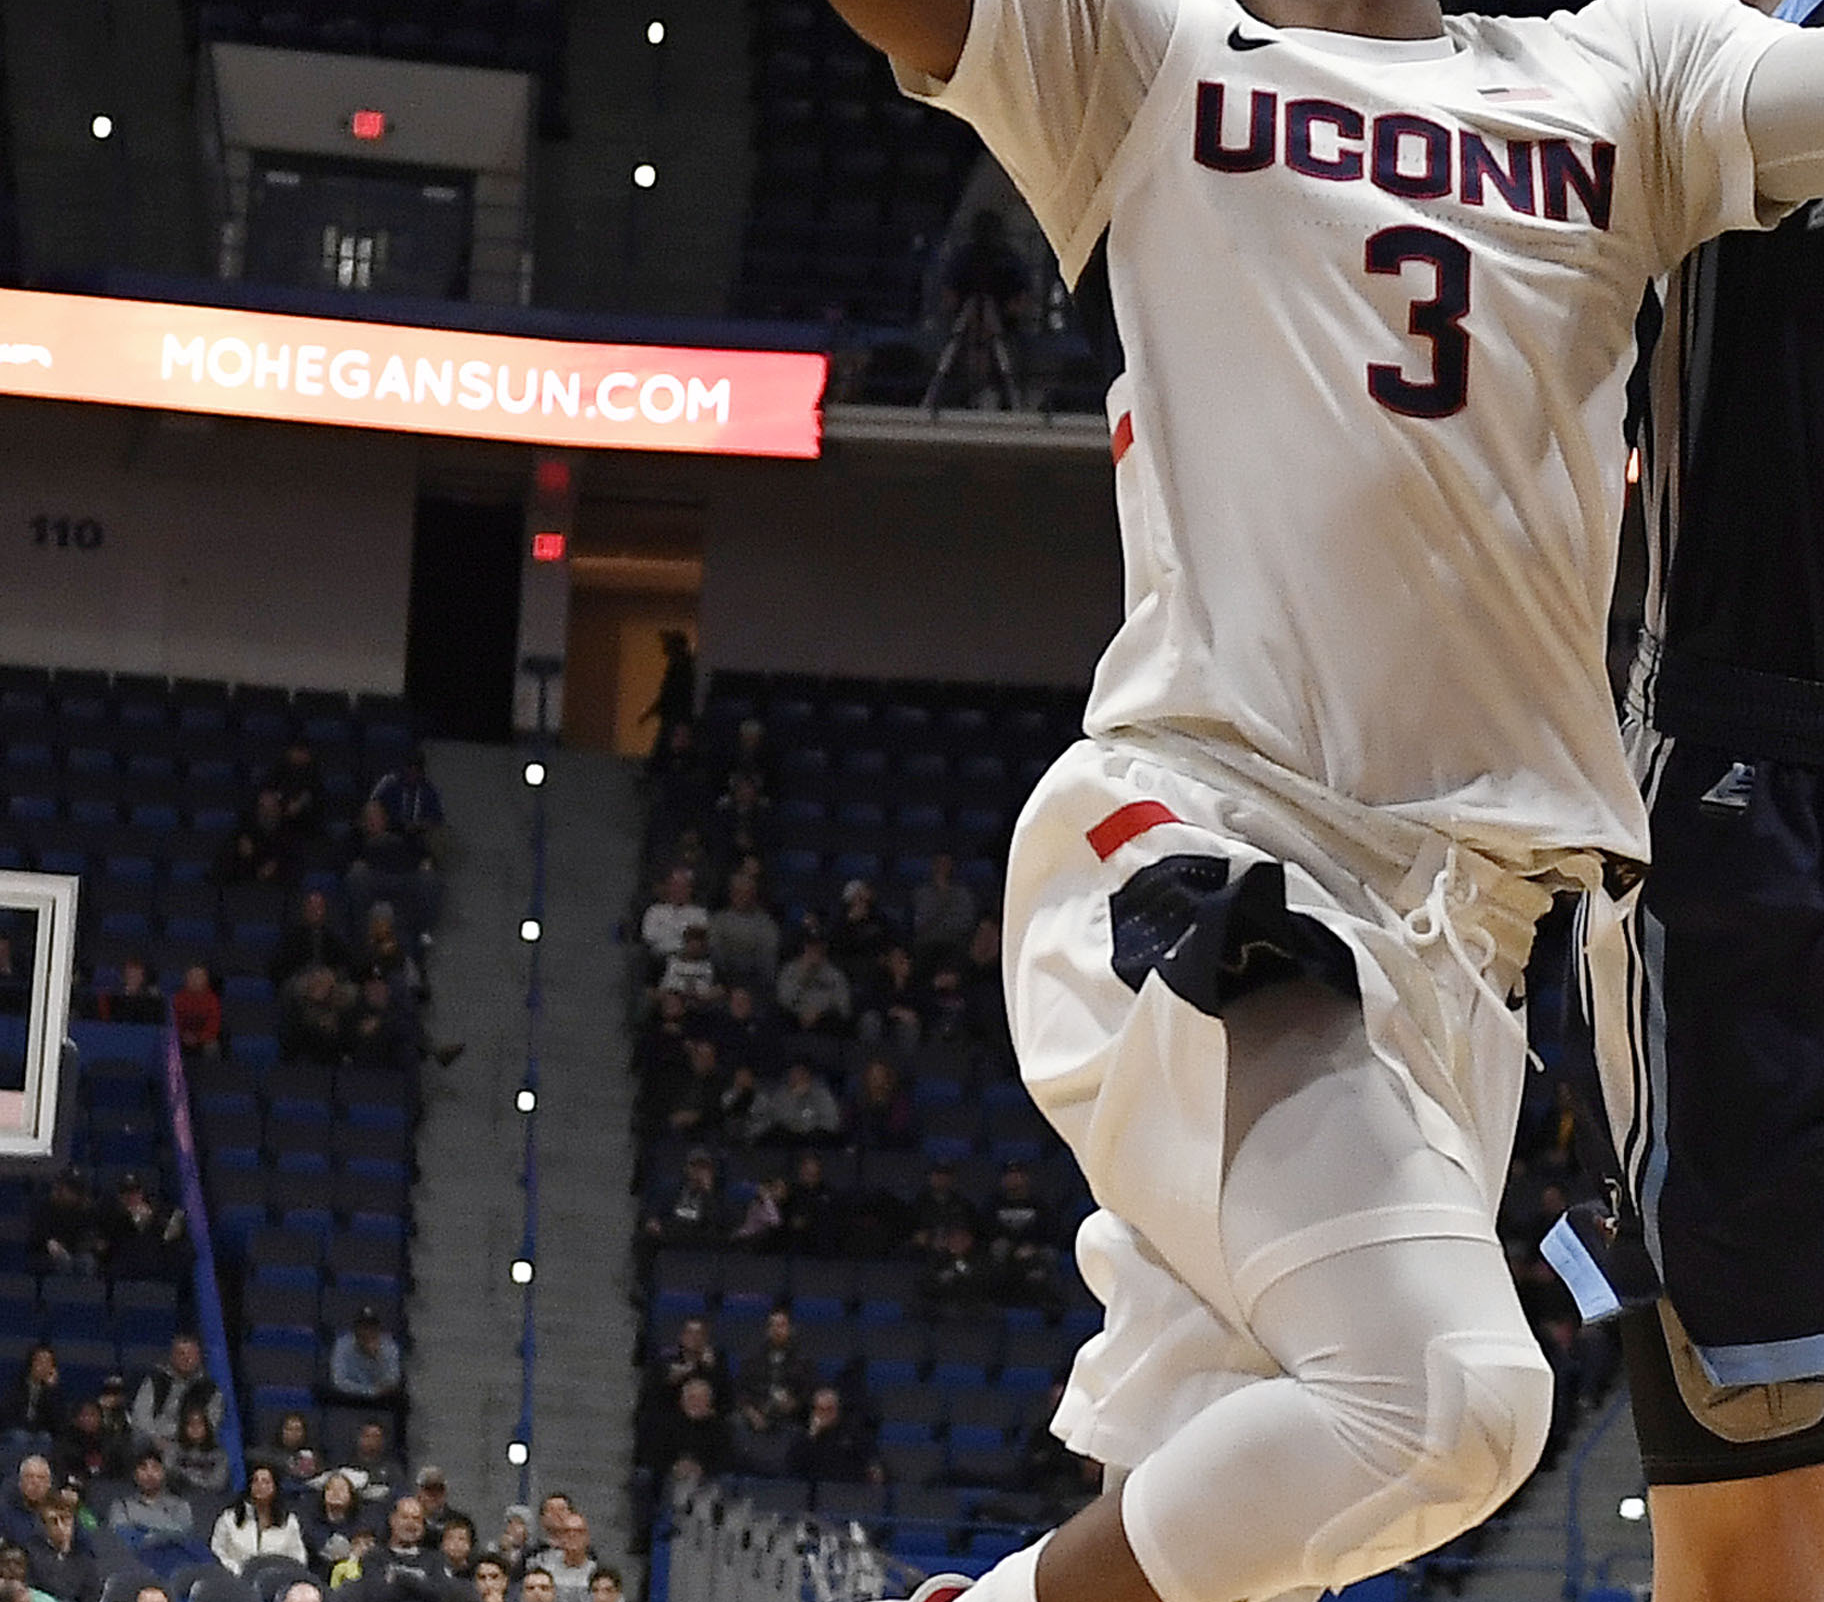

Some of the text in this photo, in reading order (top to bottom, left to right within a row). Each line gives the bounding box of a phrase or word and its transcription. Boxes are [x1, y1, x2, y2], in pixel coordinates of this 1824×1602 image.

[1194, 80, 1616, 232] UCONN
[161, 333, 732, 425] MOHEGANSUN.COM
[1364, 224, 1472, 419] 3
[30, 515, 104, 549] 110
